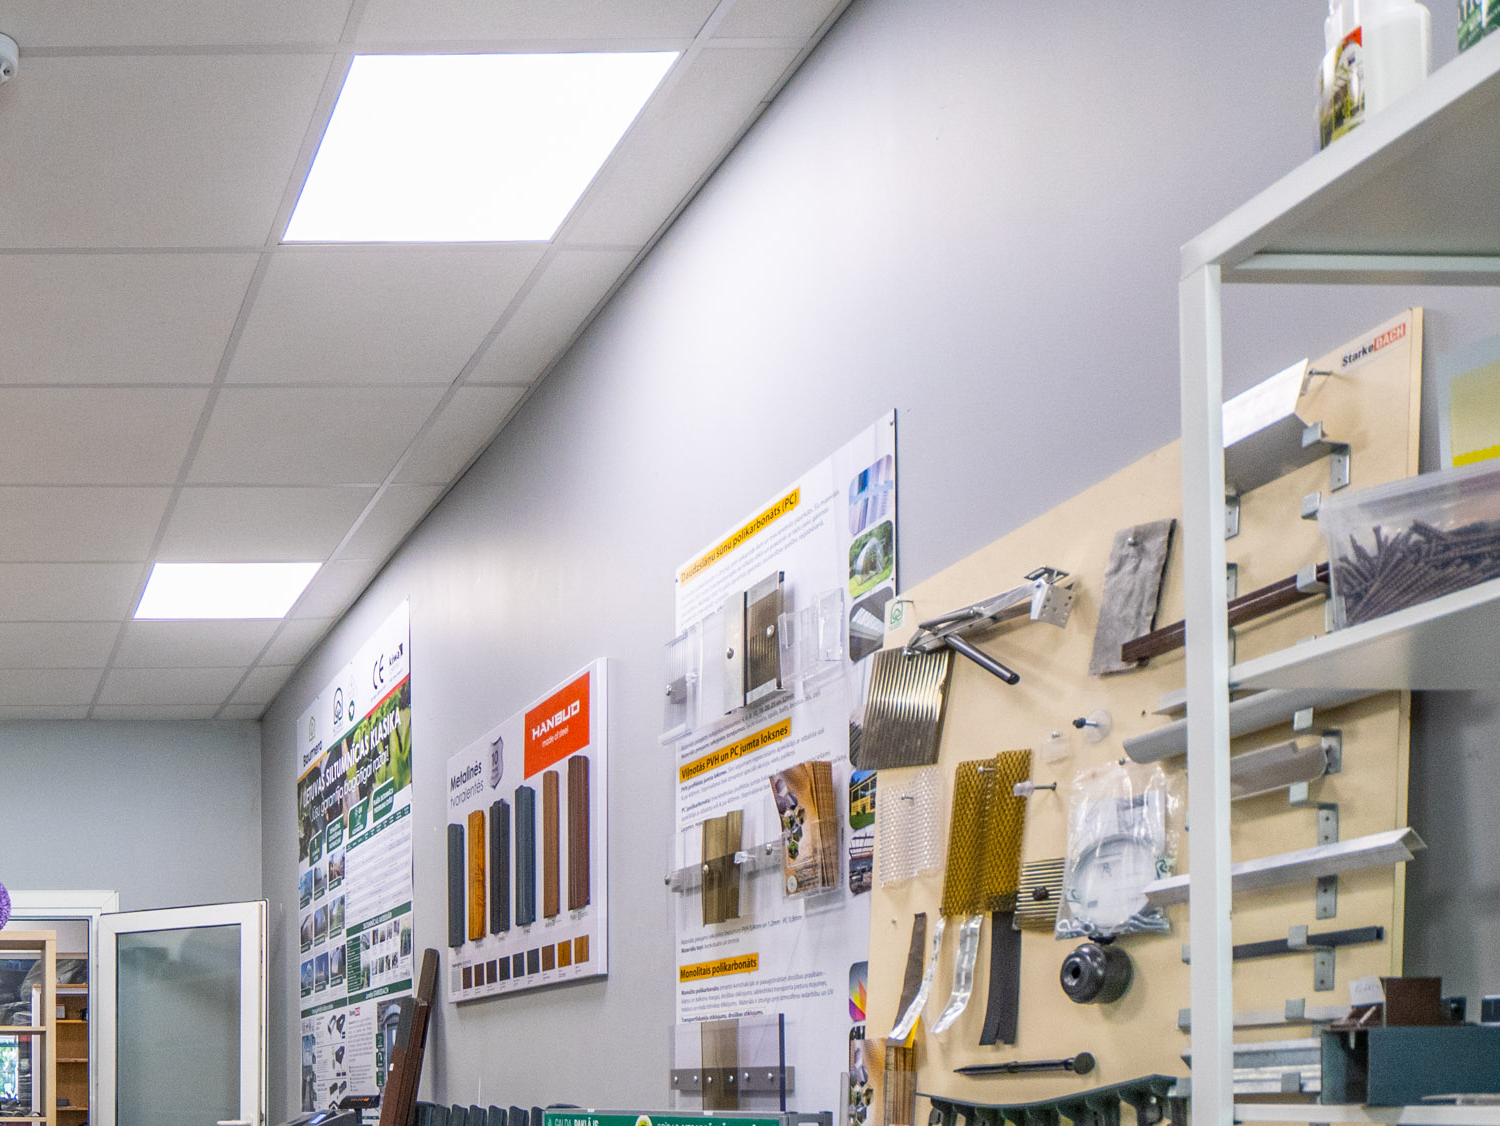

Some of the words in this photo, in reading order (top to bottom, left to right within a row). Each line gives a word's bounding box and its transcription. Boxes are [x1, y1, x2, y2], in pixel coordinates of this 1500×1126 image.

[732, 505, 781, 548] polikarbonāts
[782, 491, 797, 513] (PC)
[370, 706, 401, 750] KLASIKA
[531, 699, 580, 741] HANBUD
[706, 754, 720, 769] PVH
[720, 753, 729, 764] un
[730, 745, 739, 759] PC
[739, 739, 760, 758] jumta
[760, 725, 788, 745] loksnes
[712, 957, 757, 976] polikarbonāts
